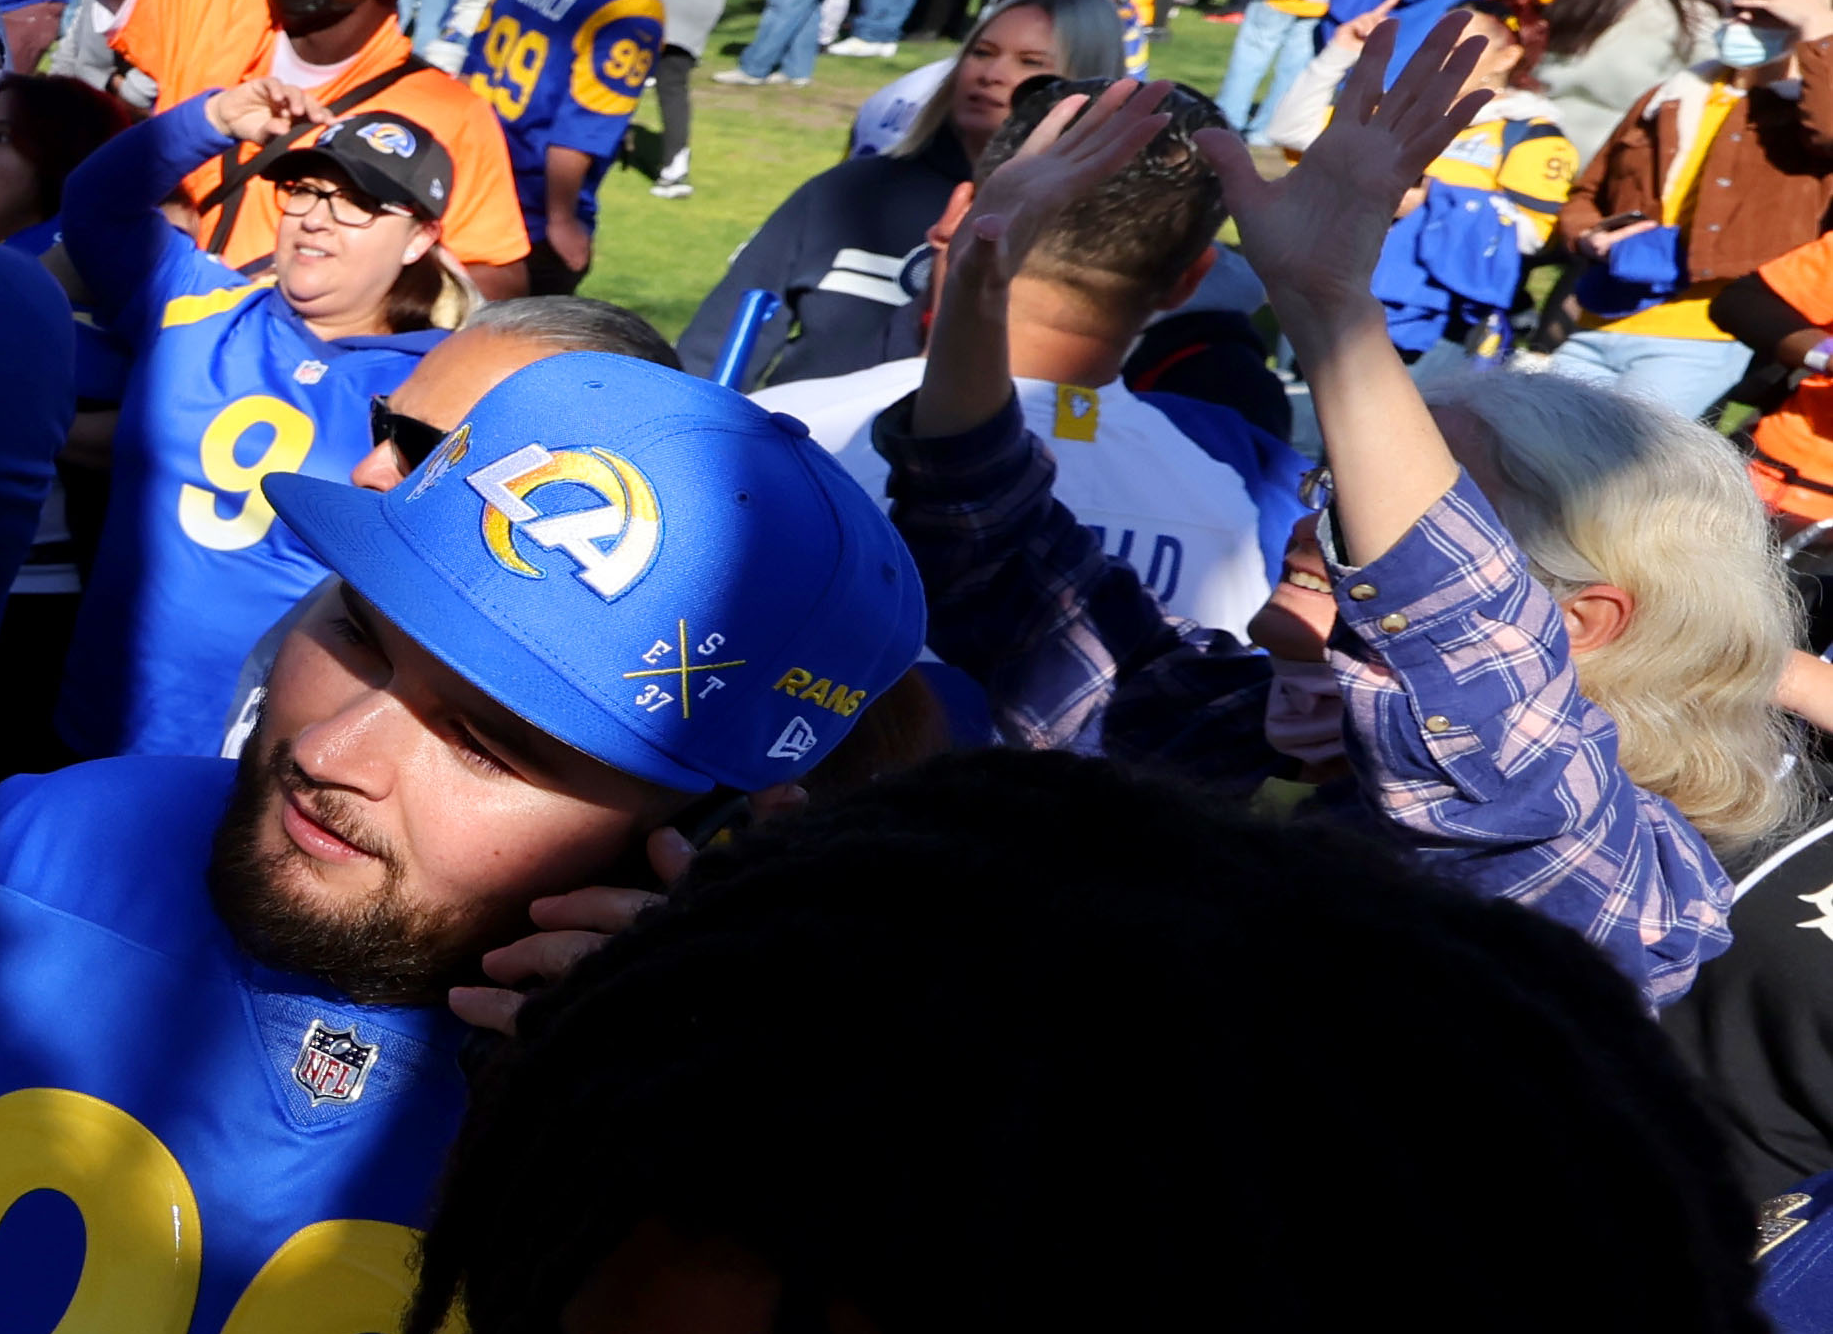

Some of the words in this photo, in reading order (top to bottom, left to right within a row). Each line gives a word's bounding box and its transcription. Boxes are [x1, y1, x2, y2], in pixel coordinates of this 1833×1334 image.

[469, 15, 549, 123] 99
[178, 394, 315, 551] 9
[634, 683, 674, 715] 37
[771, 666, 869, 720] RAMS
[299, 1047, 354, 1095] NFL
